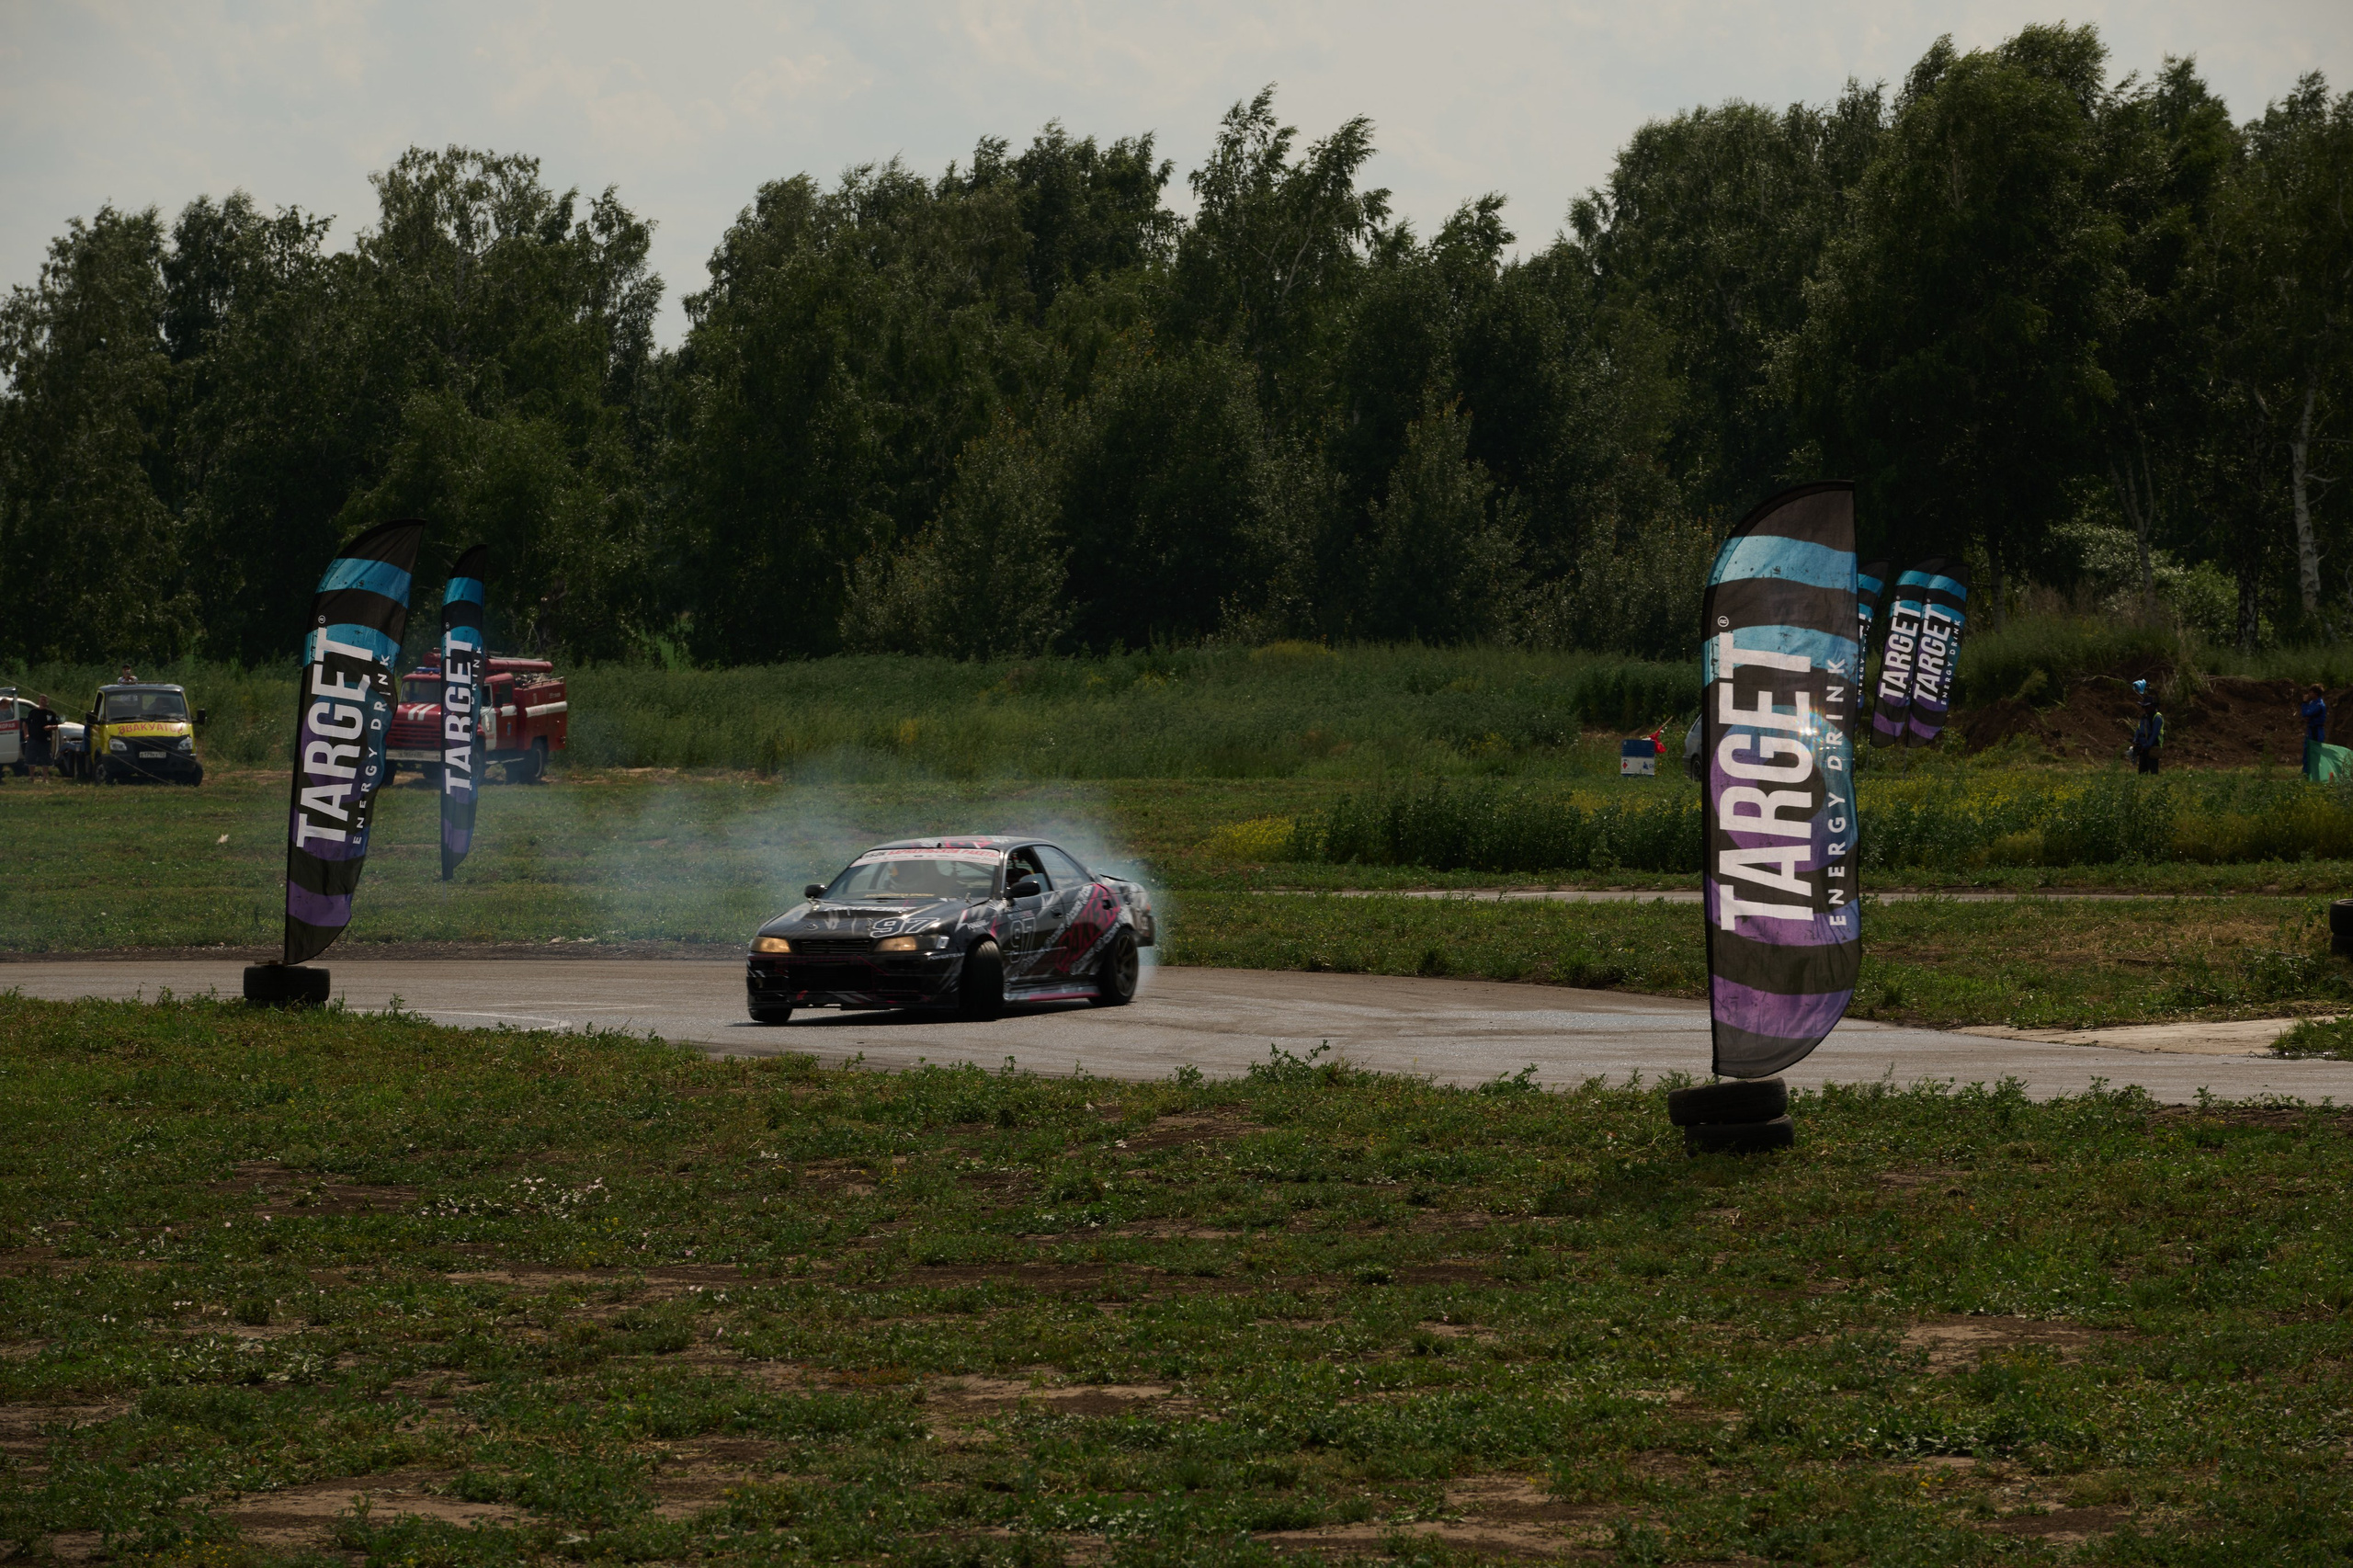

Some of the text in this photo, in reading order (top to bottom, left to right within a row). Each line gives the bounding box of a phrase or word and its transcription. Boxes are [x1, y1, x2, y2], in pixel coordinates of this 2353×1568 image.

[445, 631, 474, 795] TARGET
[1879, 600, 1922, 699] TARGET
[1913, 604, 1952, 703] TARGET
[1940, 619, 1961, 706] ENERGY DRINK
[296, 627, 374, 848] TARGET
[352, 653, 391, 845] ENERGY DRINK
[1718, 632, 1814, 932] TARGET
[1826, 658, 1847, 927] ENERGY DRINK
[870, 916, 940, 938] 97
[1009, 917, 1037, 964] 97
